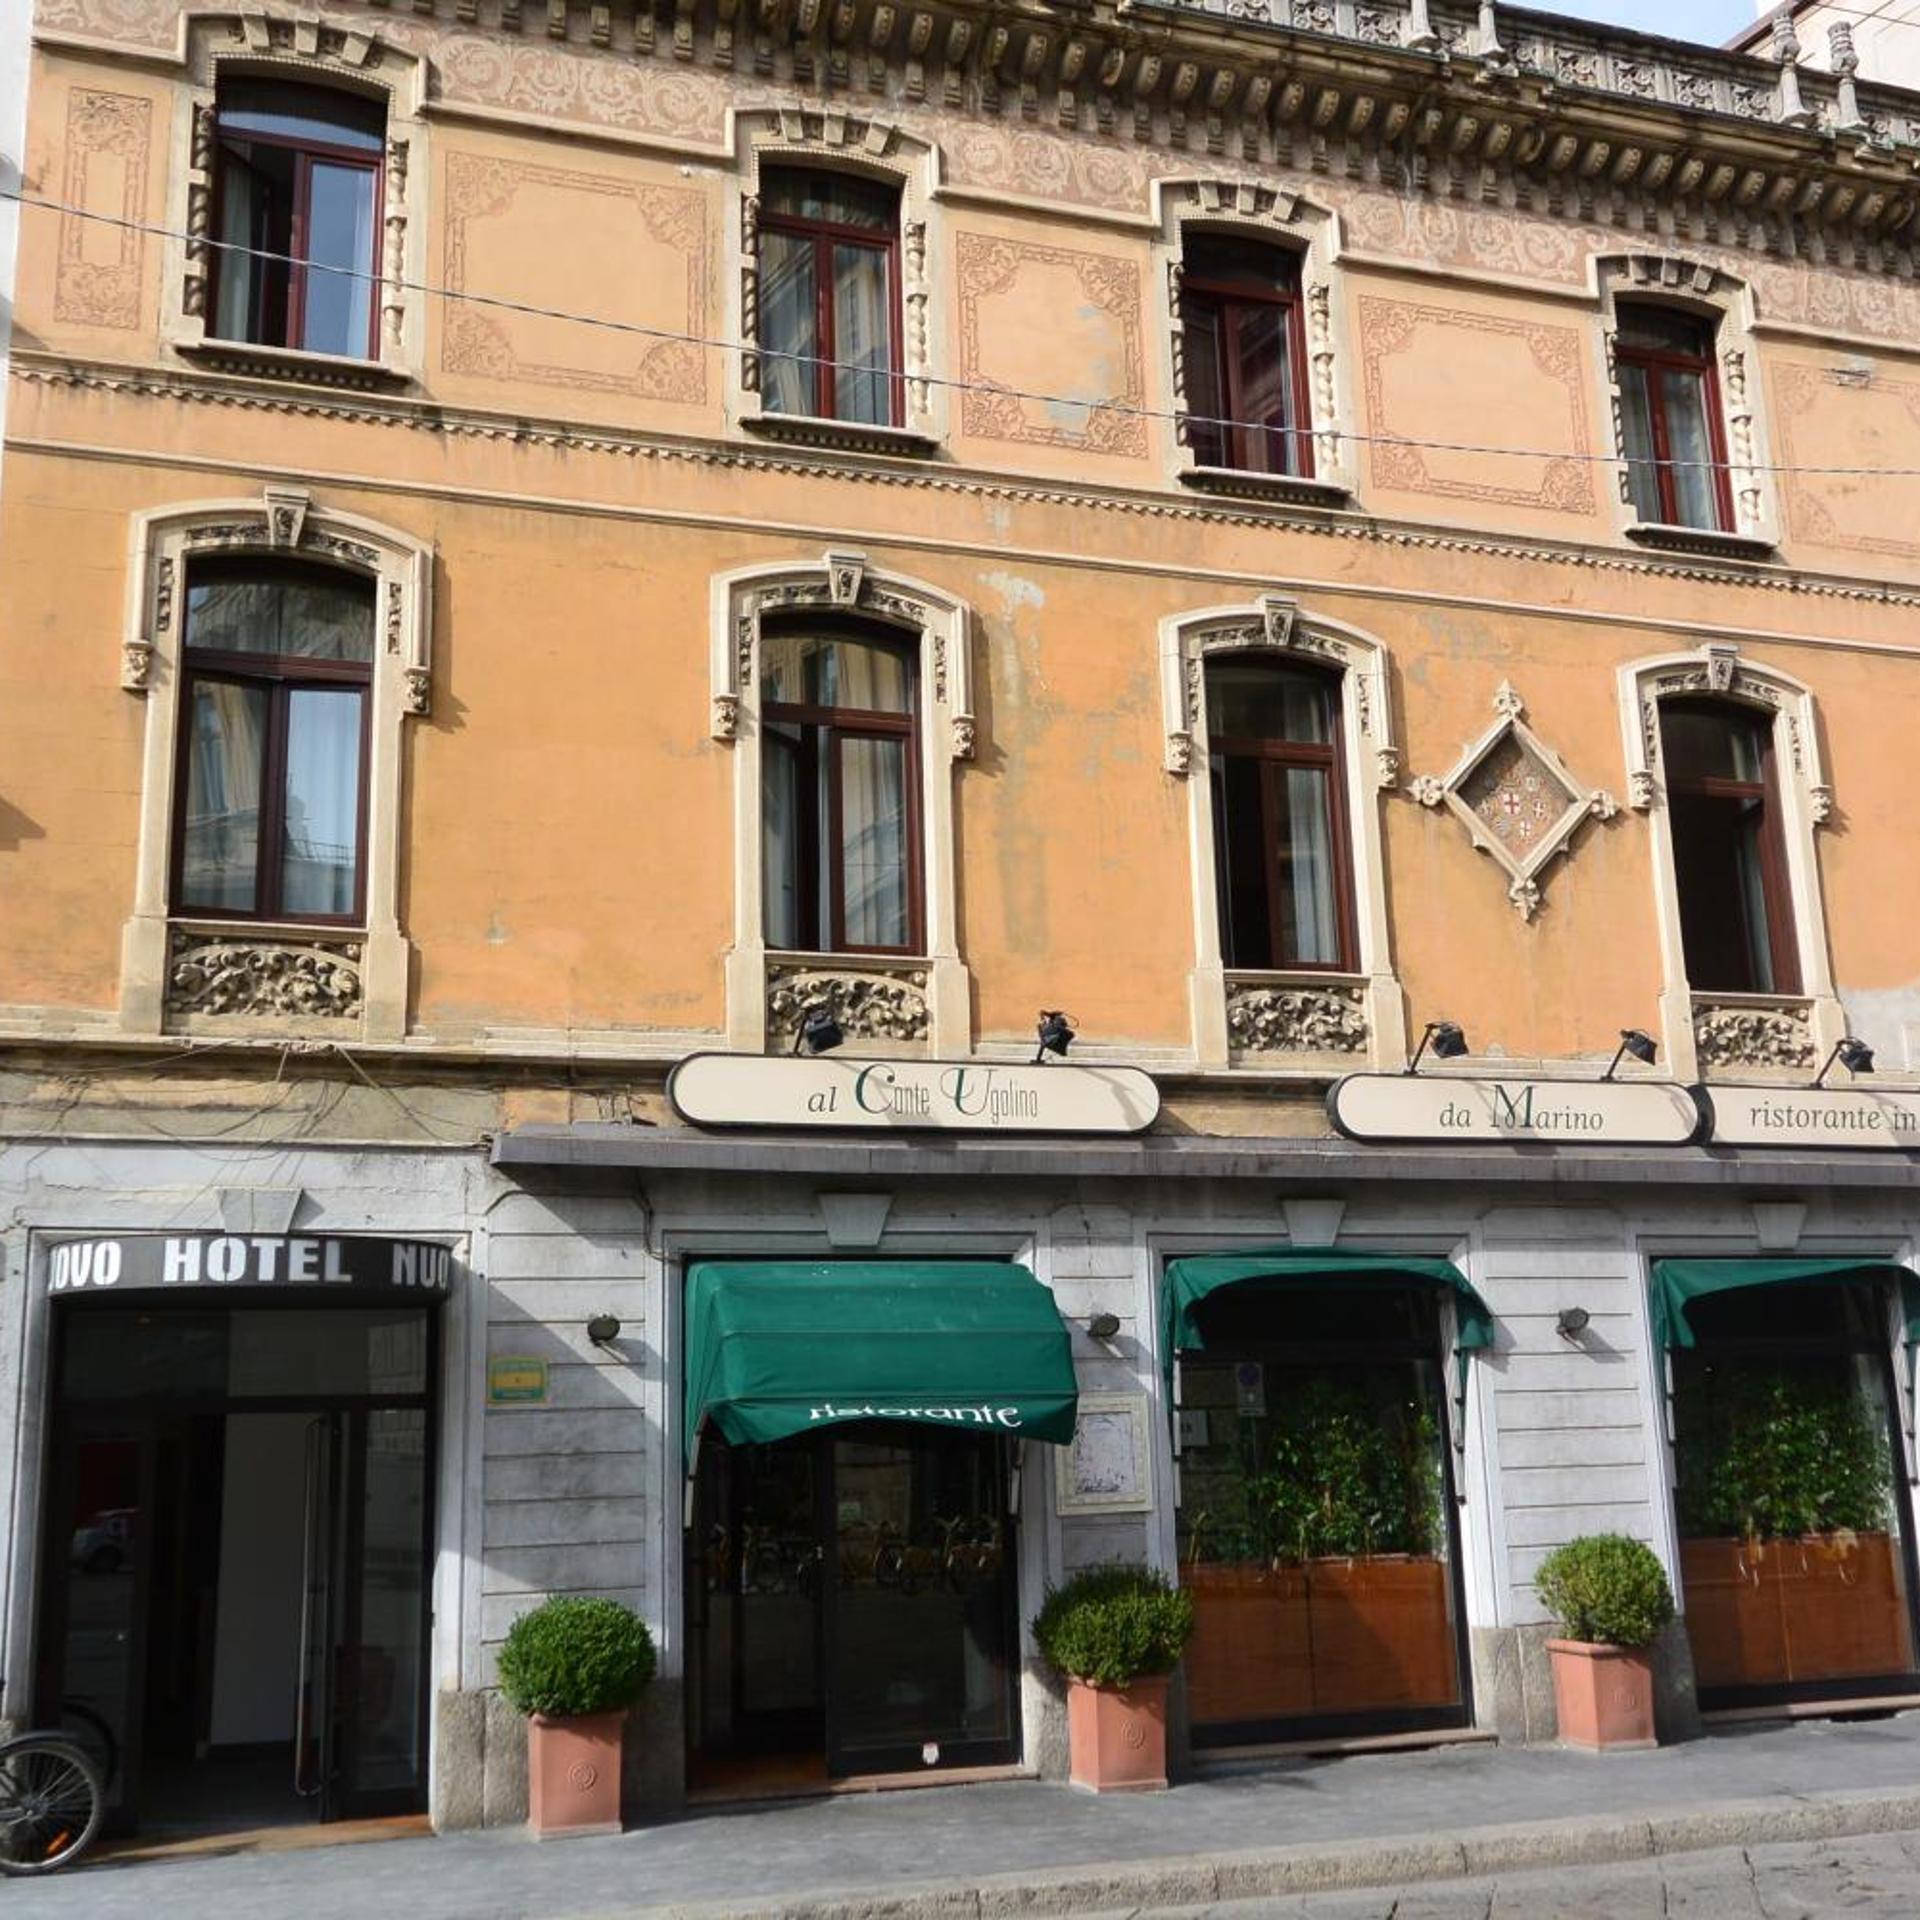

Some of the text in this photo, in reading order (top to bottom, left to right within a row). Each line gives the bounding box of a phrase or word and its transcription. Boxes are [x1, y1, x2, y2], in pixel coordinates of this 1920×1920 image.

[807, 1063, 1038, 1125] al Conte Ugolino
[1439, 1084, 1604, 1130] da Marino
[1750, 1100, 1881, 1130] ristorante
[163, 1237, 352, 1283] HOTEL
[809, 1403, 1022, 1428] ristorante
